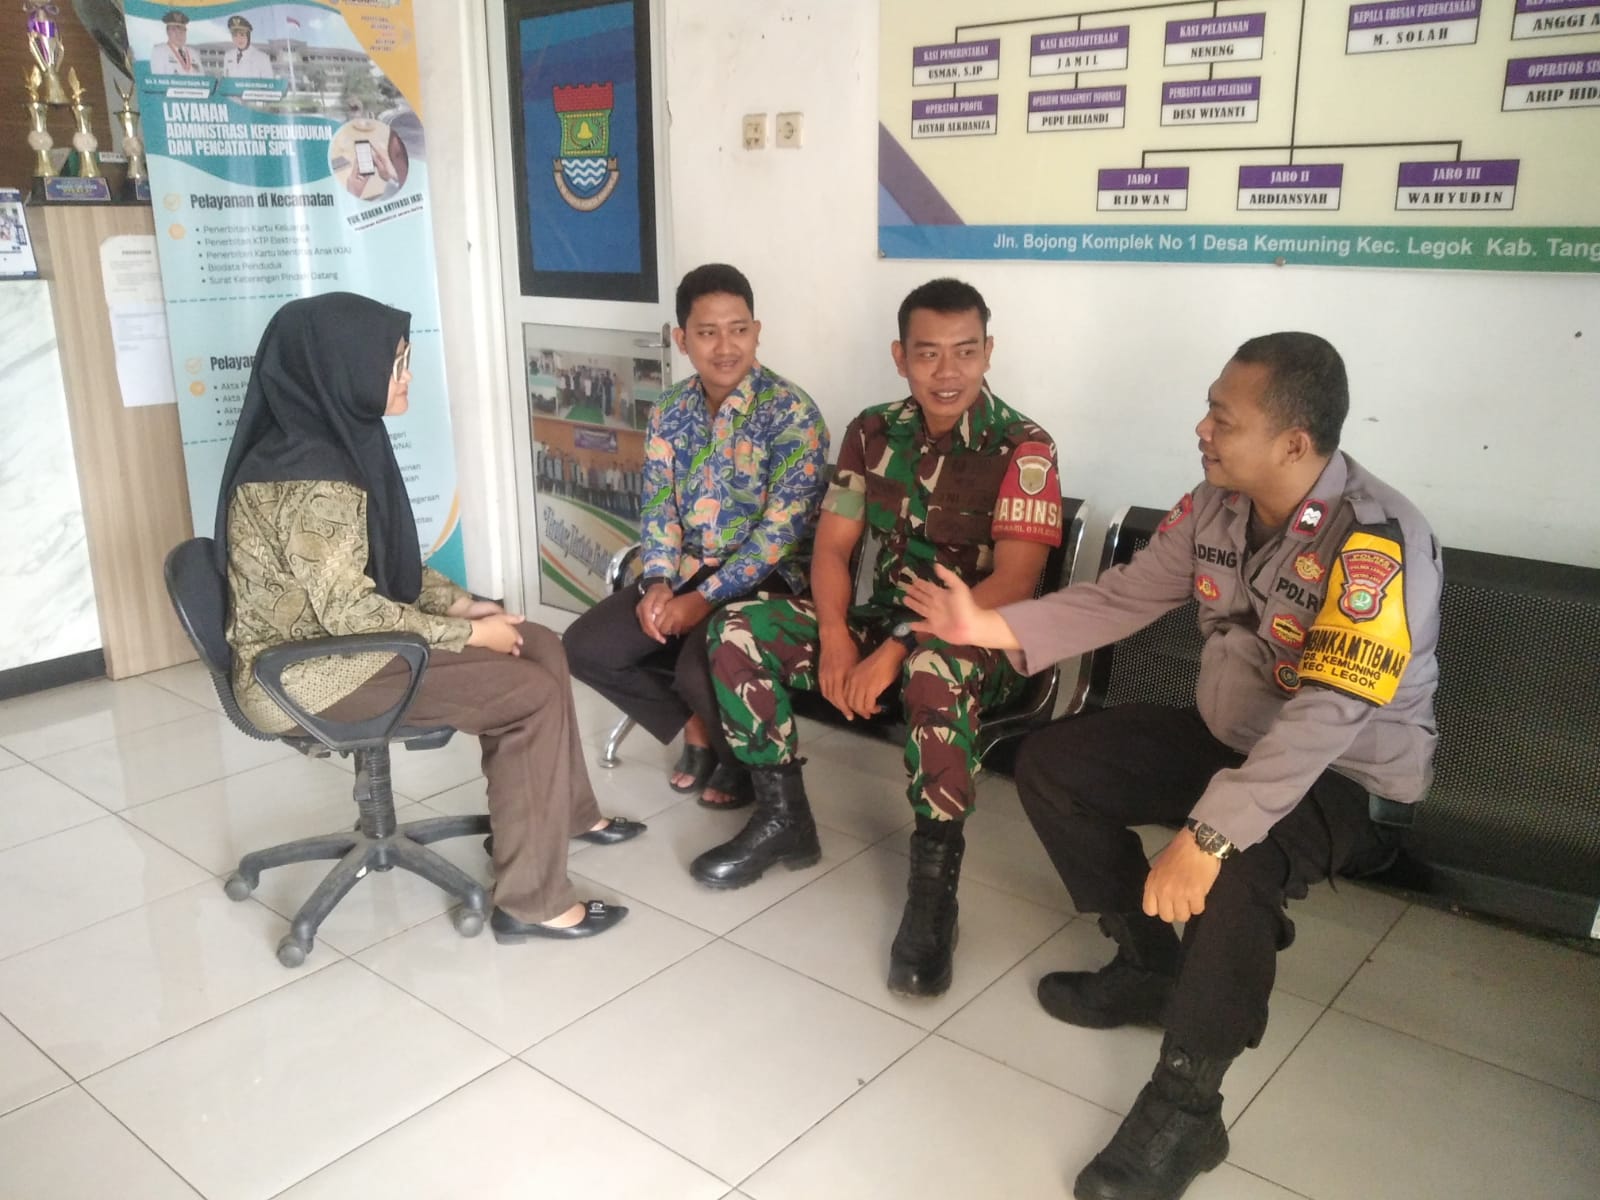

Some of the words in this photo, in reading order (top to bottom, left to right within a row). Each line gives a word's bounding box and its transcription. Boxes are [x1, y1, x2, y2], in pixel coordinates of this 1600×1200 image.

[1354, 9, 1383, 24] KEPALA
[1533, 14, 1586, 32] ANGGI
[1180, 24, 1199, 38] KASI
[1201, 20, 1249, 36] PELAYANAN
[1373, 33, 1389, 45] M.
[1397, 27, 1448, 44] SOLAH
[1040, 38, 1057, 50] KASI
[1191, 44, 1234, 58] NENENG
[923, 50, 939, 61] KASI
[940, 45, 989, 59] PEMERINTAHAN
[928, 67, 960, 80] USMAN,
[1528, 61, 1585, 78] OPERATOR
[1526, 89, 1564, 103] ARIP
[163, 102, 229, 122] LAYANAN
[925, 102, 959, 114] OPERATOR
[960, 100, 983, 112] PROFIL
[1173, 109, 1196, 120] DESI
[1200, 106, 1246, 119] WIYANTI
[166, 123, 249, 140] ADMINISTRASI
[250, 124, 333, 141] KEPENDUDUKAN
[918, 123, 945, 133] AISYAH
[168, 141, 193, 155] DAN
[195, 140, 267, 156] PENCATATAN
[268, 141, 297, 156] SIPIL
[1127, 174, 1151, 186] JARO
[1270, 171, 1297, 184] JARO
[1301, 171, 1310, 182] II
[1432, 168, 1463, 182] JARO
[1465, 167, 1482, 180] III
[190, 193, 257, 210] Pelayanan
[257, 192, 269, 208] di
[270, 193, 334, 208] Kecamatan
[1113, 195, 1170, 206] RIDWAN
[1249, 193, 1328, 206] ARDIANSYAH
[1408, 192, 1504, 204] WAHYUDIN
[251, 225, 274, 233] Kartu
[253, 237, 269, 245] KTP
[993, 234, 1019, 249] Jln.
[1023, 234, 1077, 252] Bojong
[1082, 234, 1154, 252] Komplek
[1158, 236, 1182, 250] No
[1188, 235, 1197, 250] 1
[1203, 235, 1248, 251] Desa
[1253, 235, 1350, 257] Kemuning
[1356, 236, 1401, 254] Kec.
[1407, 237, 1473, 259] Legok
[1486, 238, 1538, 256] Kab.
[1322, 654, 1382, 680] KEMUNING
[1303, 661, 1327, 673] KEC.
[1331, 667, 1377, 690] LEGOK
